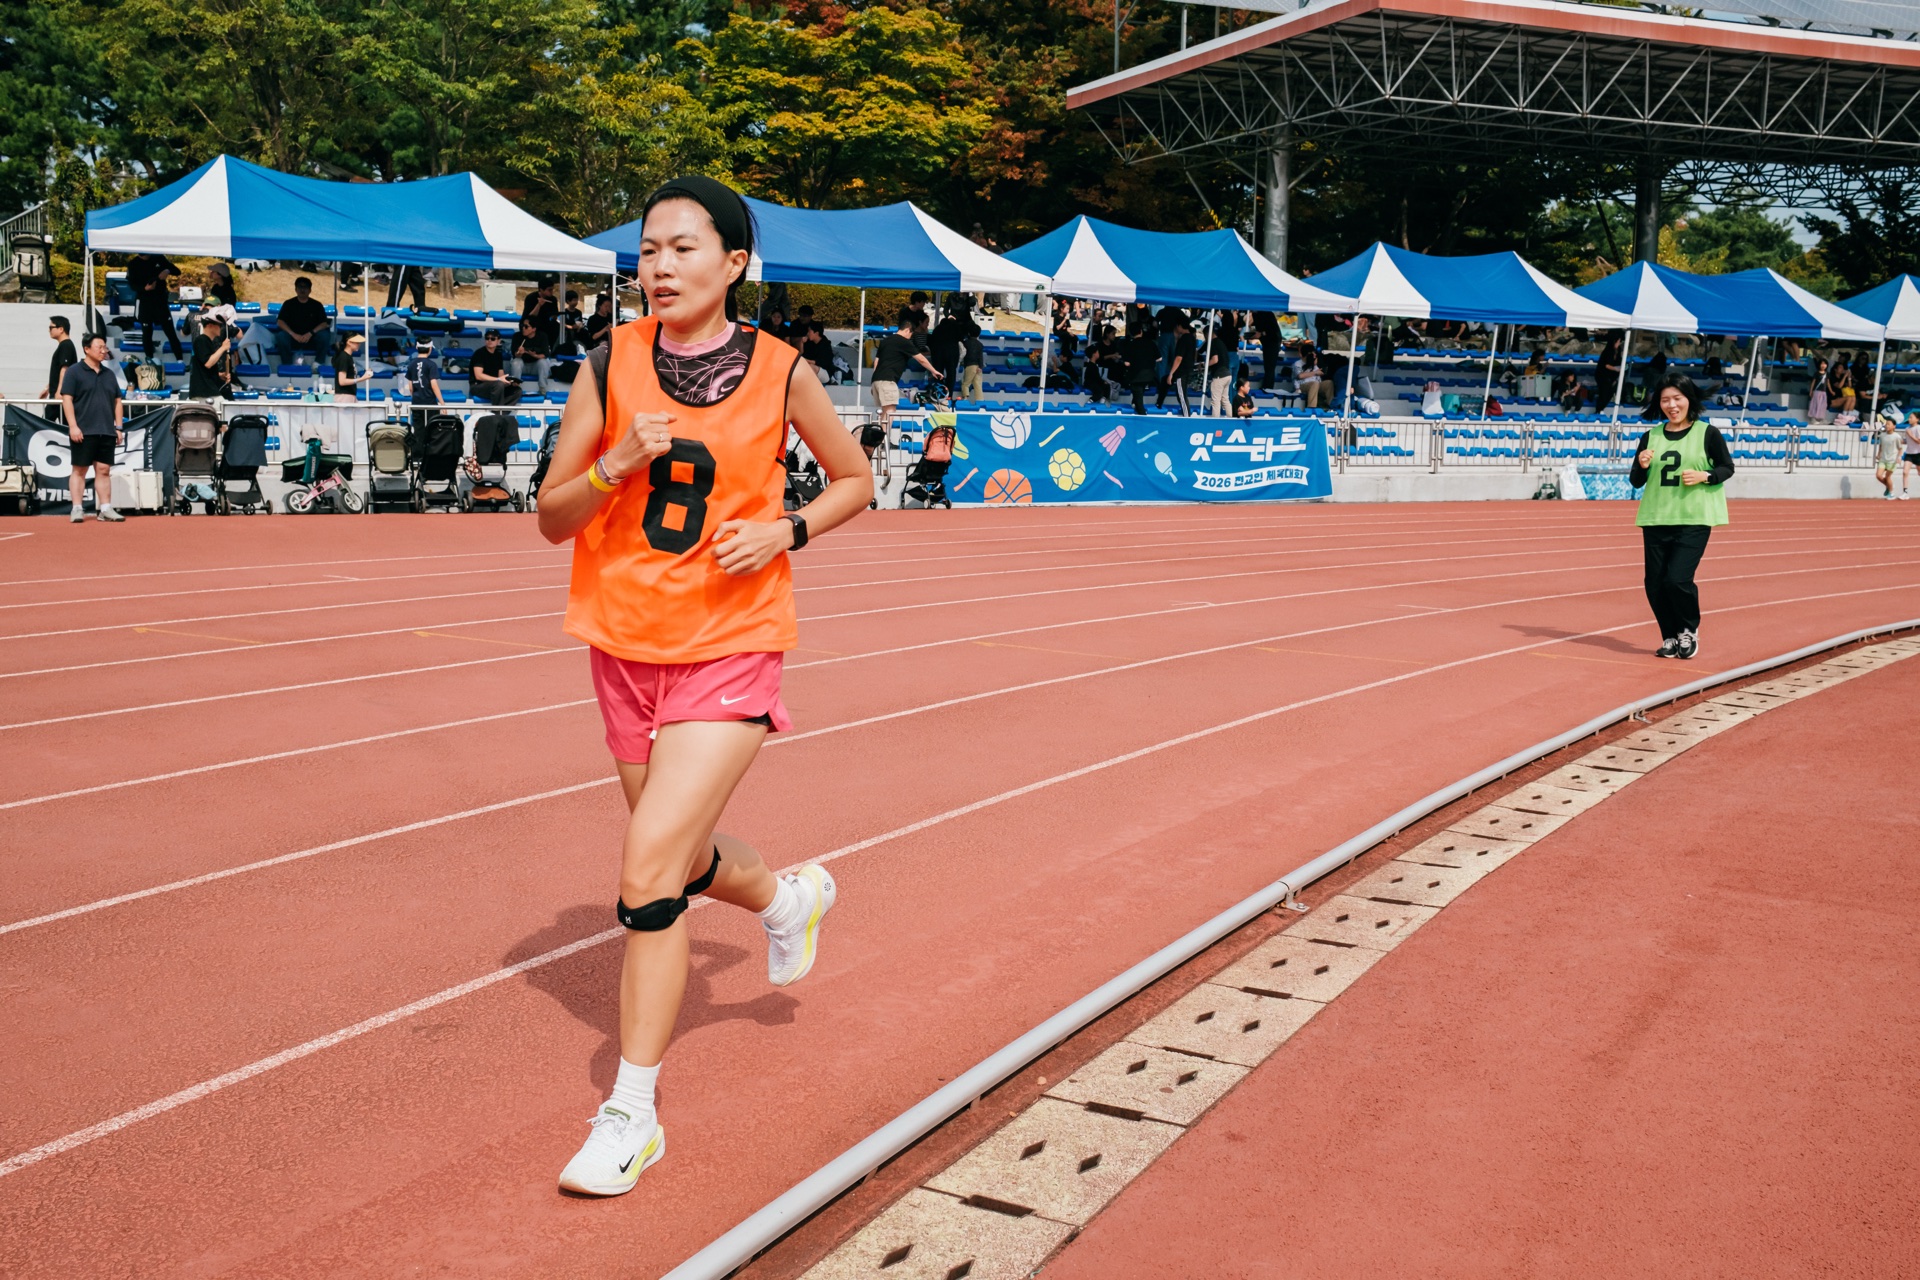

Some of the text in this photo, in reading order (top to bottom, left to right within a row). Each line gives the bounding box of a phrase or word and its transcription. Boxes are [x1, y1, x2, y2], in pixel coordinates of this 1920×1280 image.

[1201, 468, 1304, 488] 2026 전교인 체육대회
[1660, 450, 1682, 487] 2
[642, 437, 716, 555] 8
